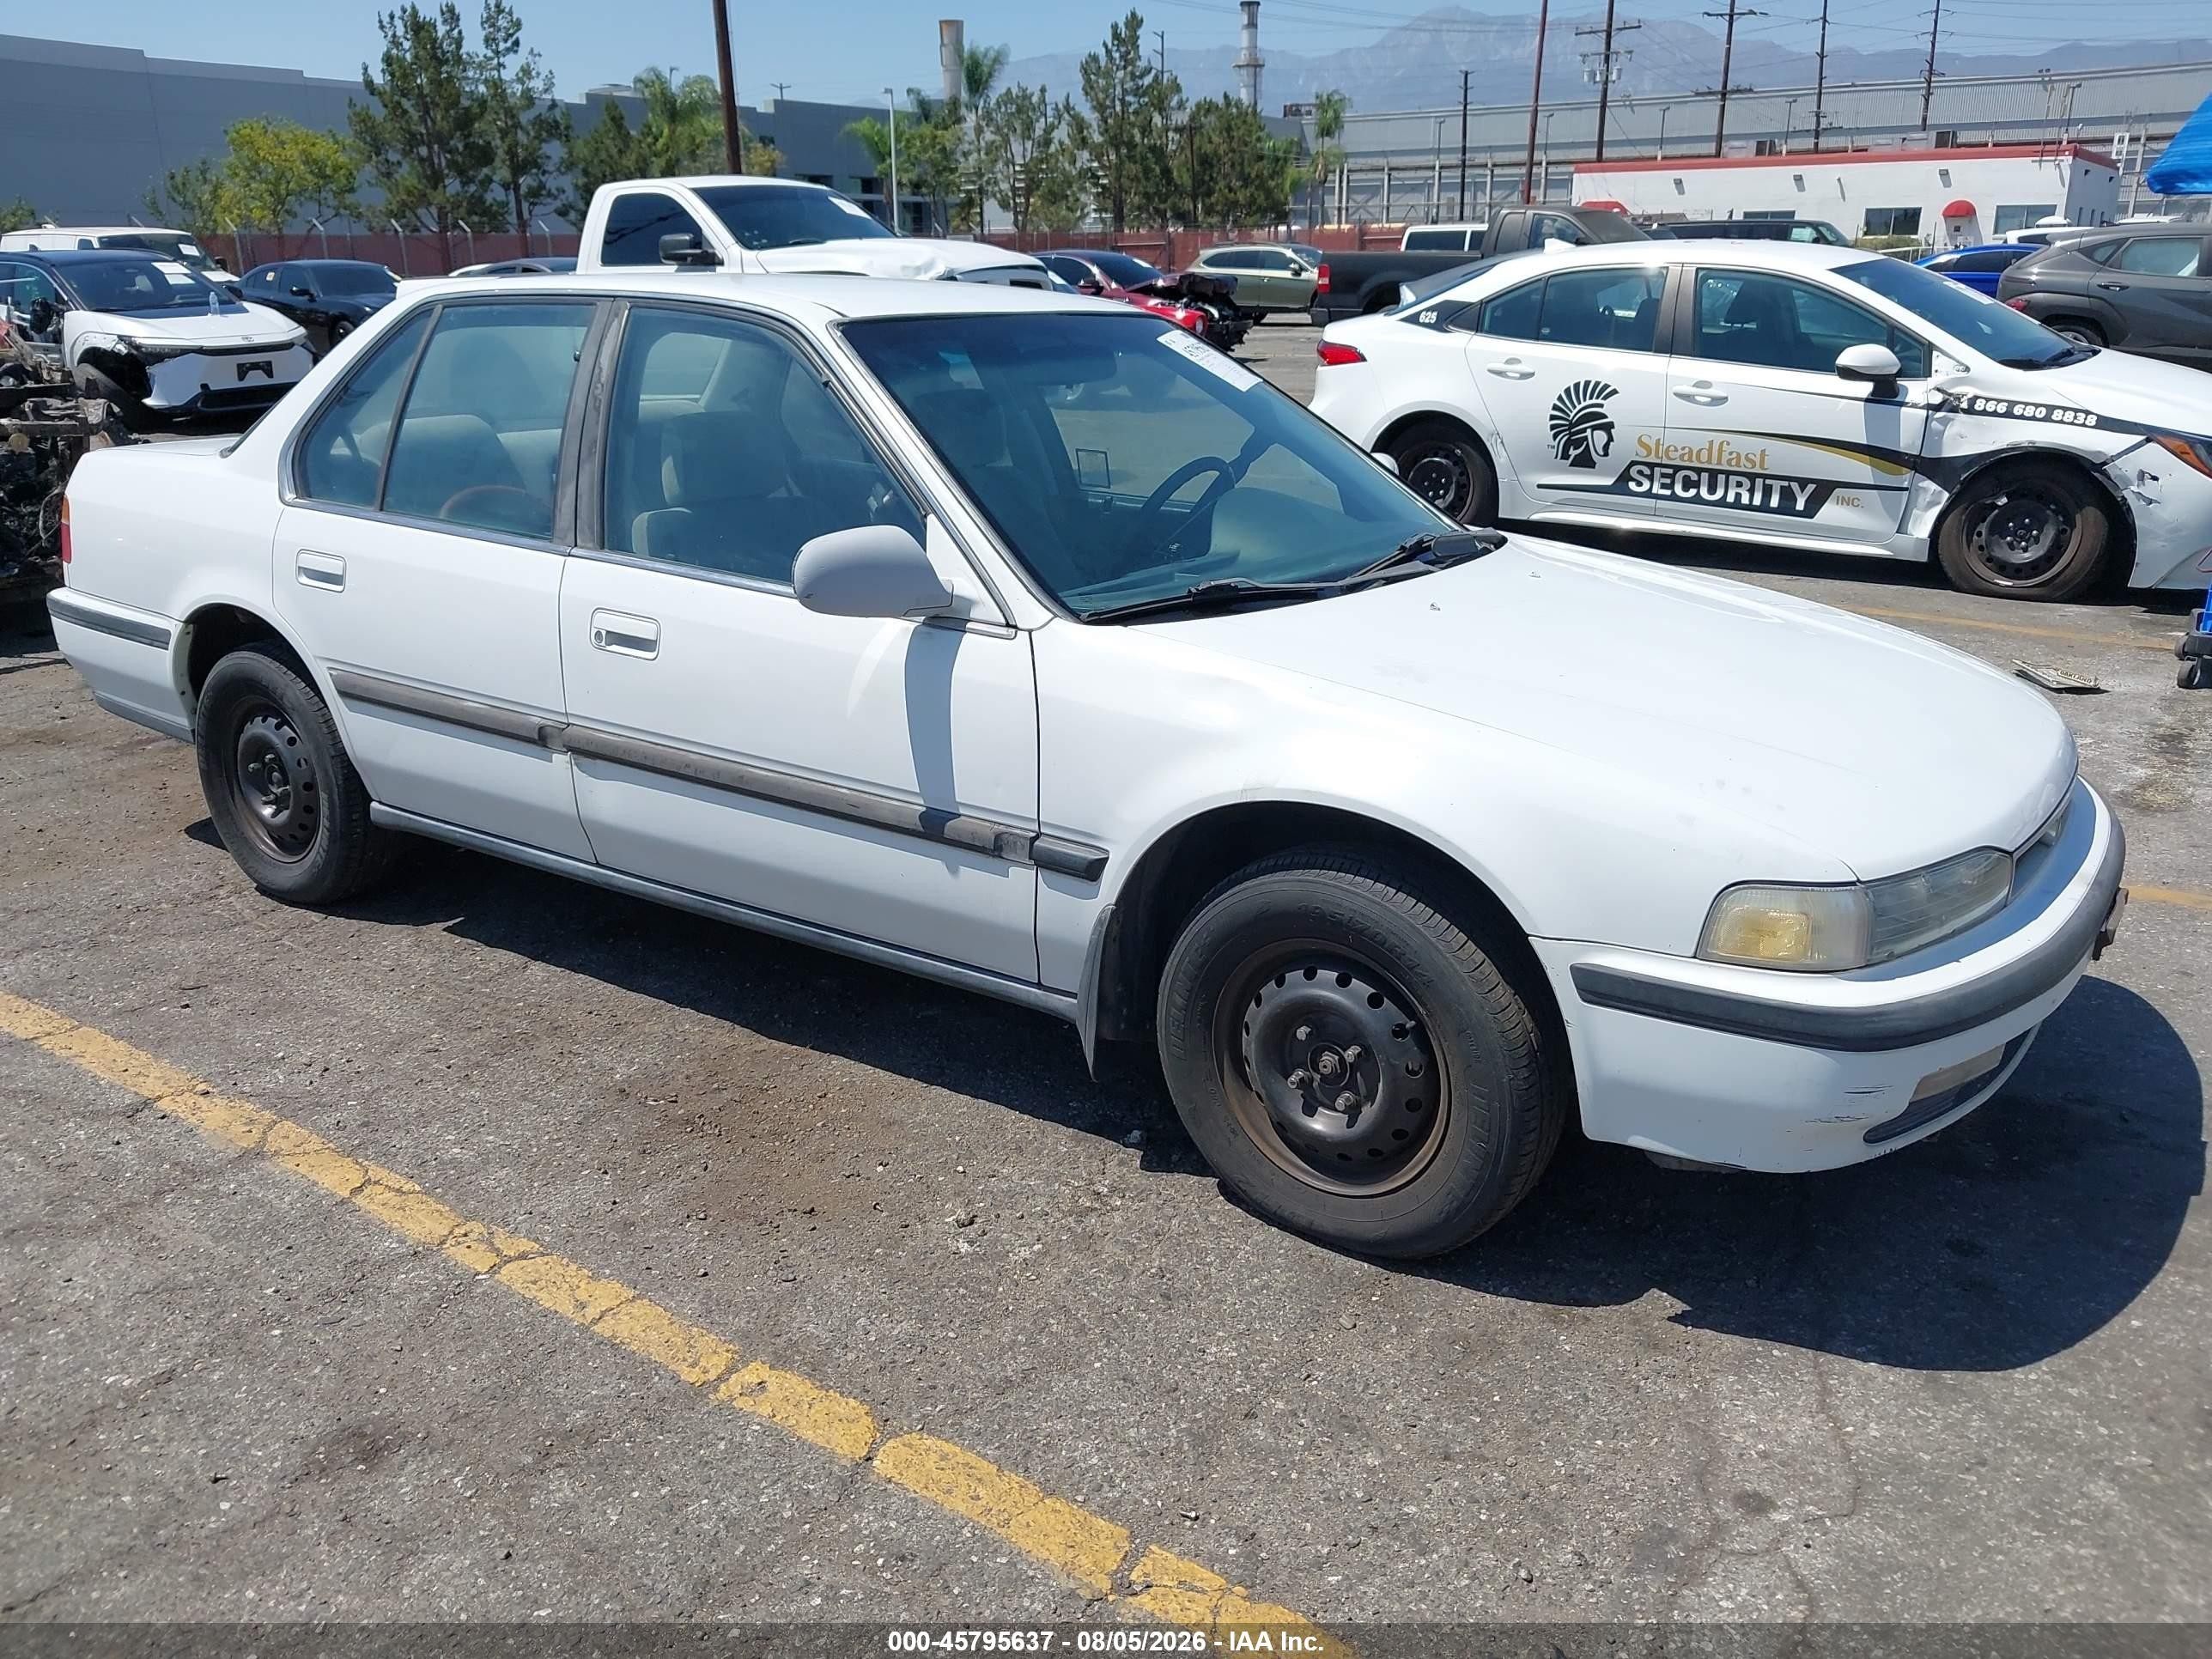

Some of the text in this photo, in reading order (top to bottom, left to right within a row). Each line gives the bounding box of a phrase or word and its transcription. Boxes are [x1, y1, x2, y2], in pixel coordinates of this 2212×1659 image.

[1419, 310, 1438, 324] 625
[1974, 398, 2008, 414] 866
[2013, 404, 2046, 418] 680
[2051, 410, 2098, 426] 8838
[1635, 434, 1770, 471] Steadfast
[1627, 465, 1864, 511] SECURITY INC.
